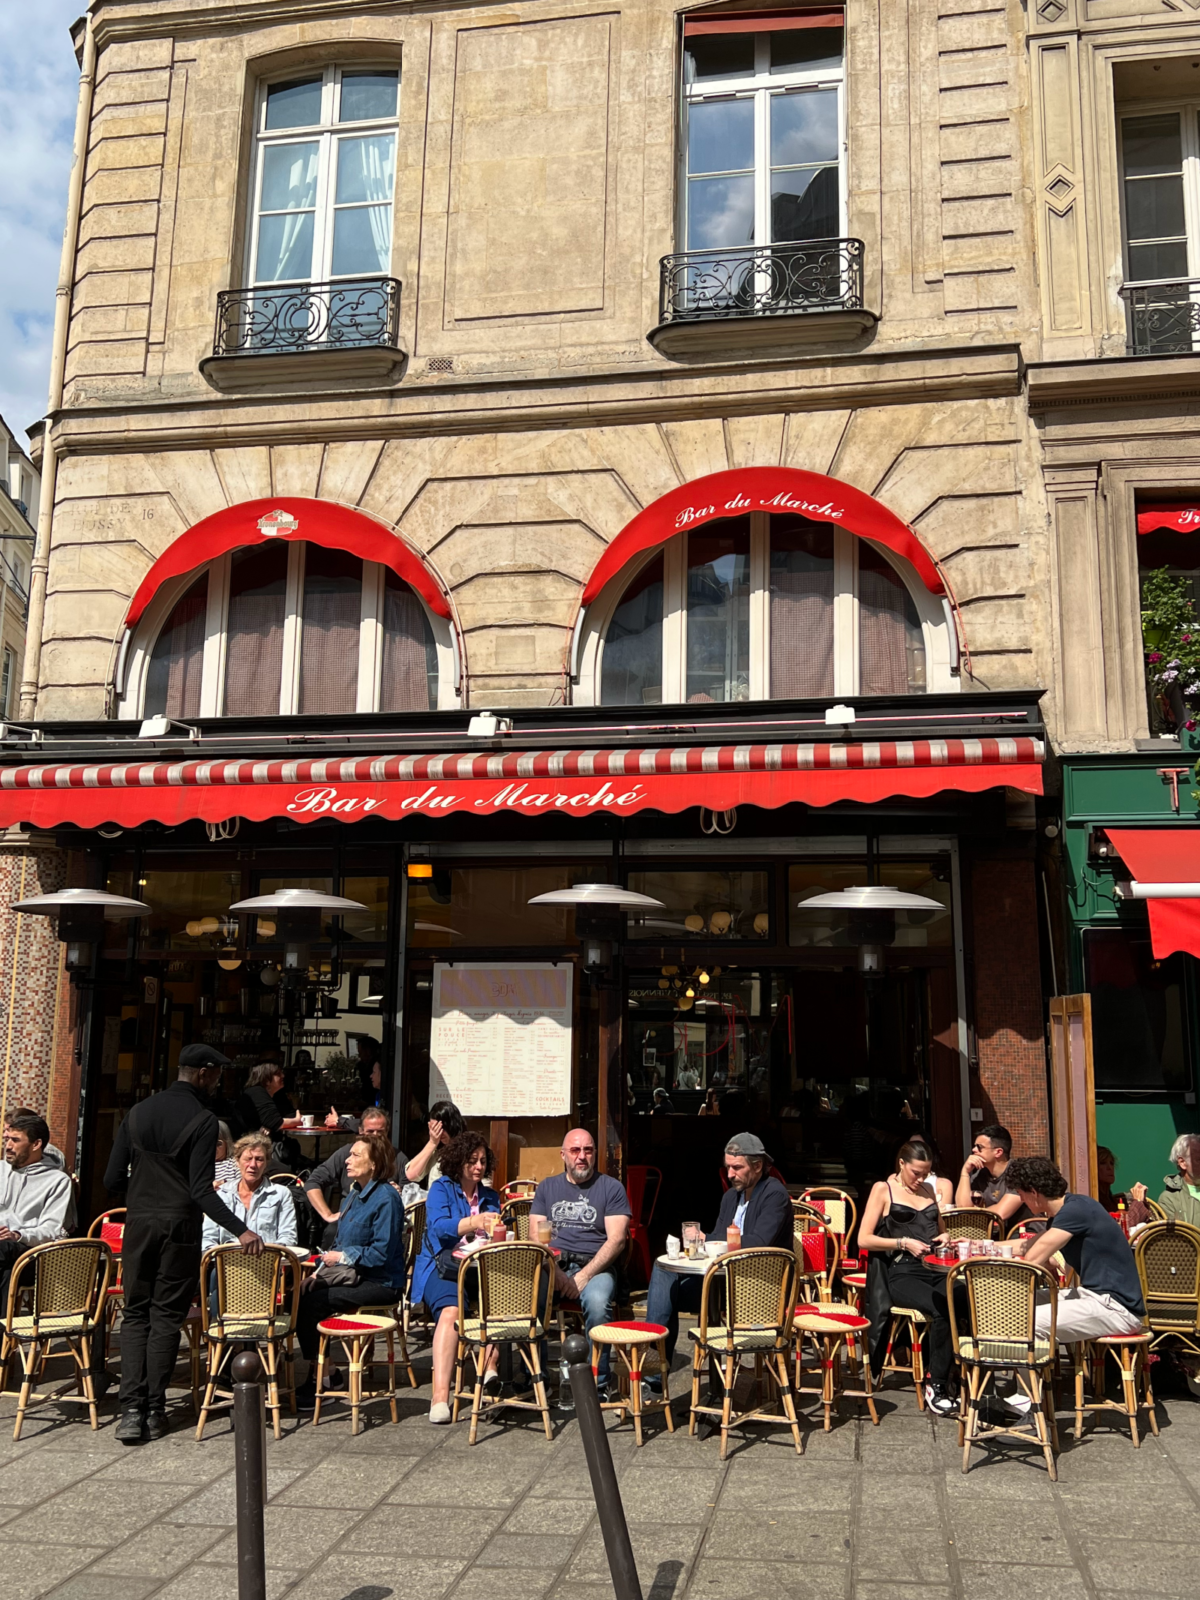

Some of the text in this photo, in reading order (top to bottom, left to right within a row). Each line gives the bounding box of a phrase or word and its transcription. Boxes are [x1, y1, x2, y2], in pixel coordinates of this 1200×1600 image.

[142, 508, 155, 521] 16
[674, 491, 845, 528] Bar du Marché
[256, 518, 299, 531] Kronenbourg
[286, 781, 647, 814] Bar du Marché
